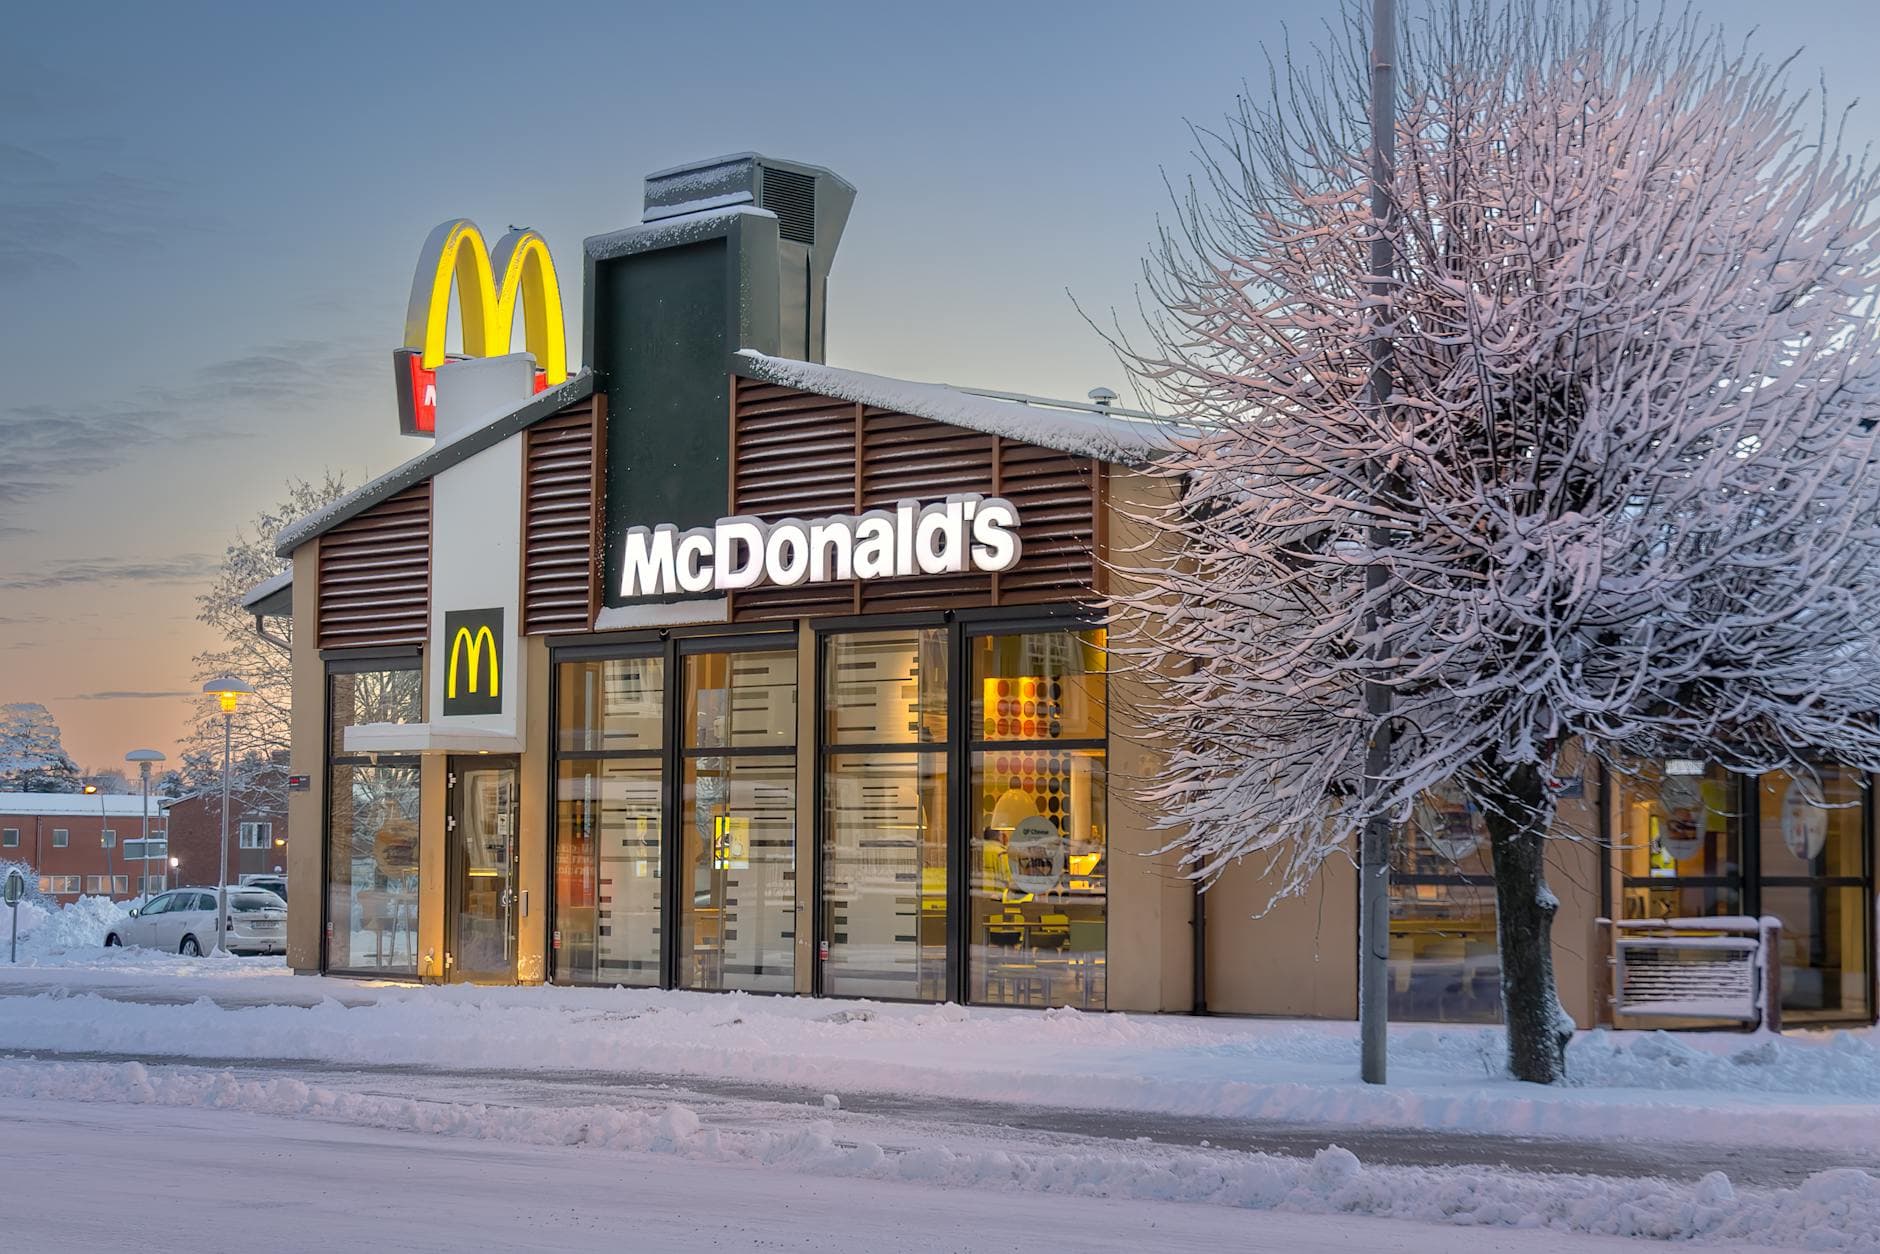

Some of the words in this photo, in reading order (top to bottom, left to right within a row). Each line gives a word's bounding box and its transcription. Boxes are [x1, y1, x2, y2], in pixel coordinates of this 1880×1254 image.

[411, 219, 568, 386] M
[620, 495, 1021, 598] McDonald's
[448, 625, 499, 699] M
